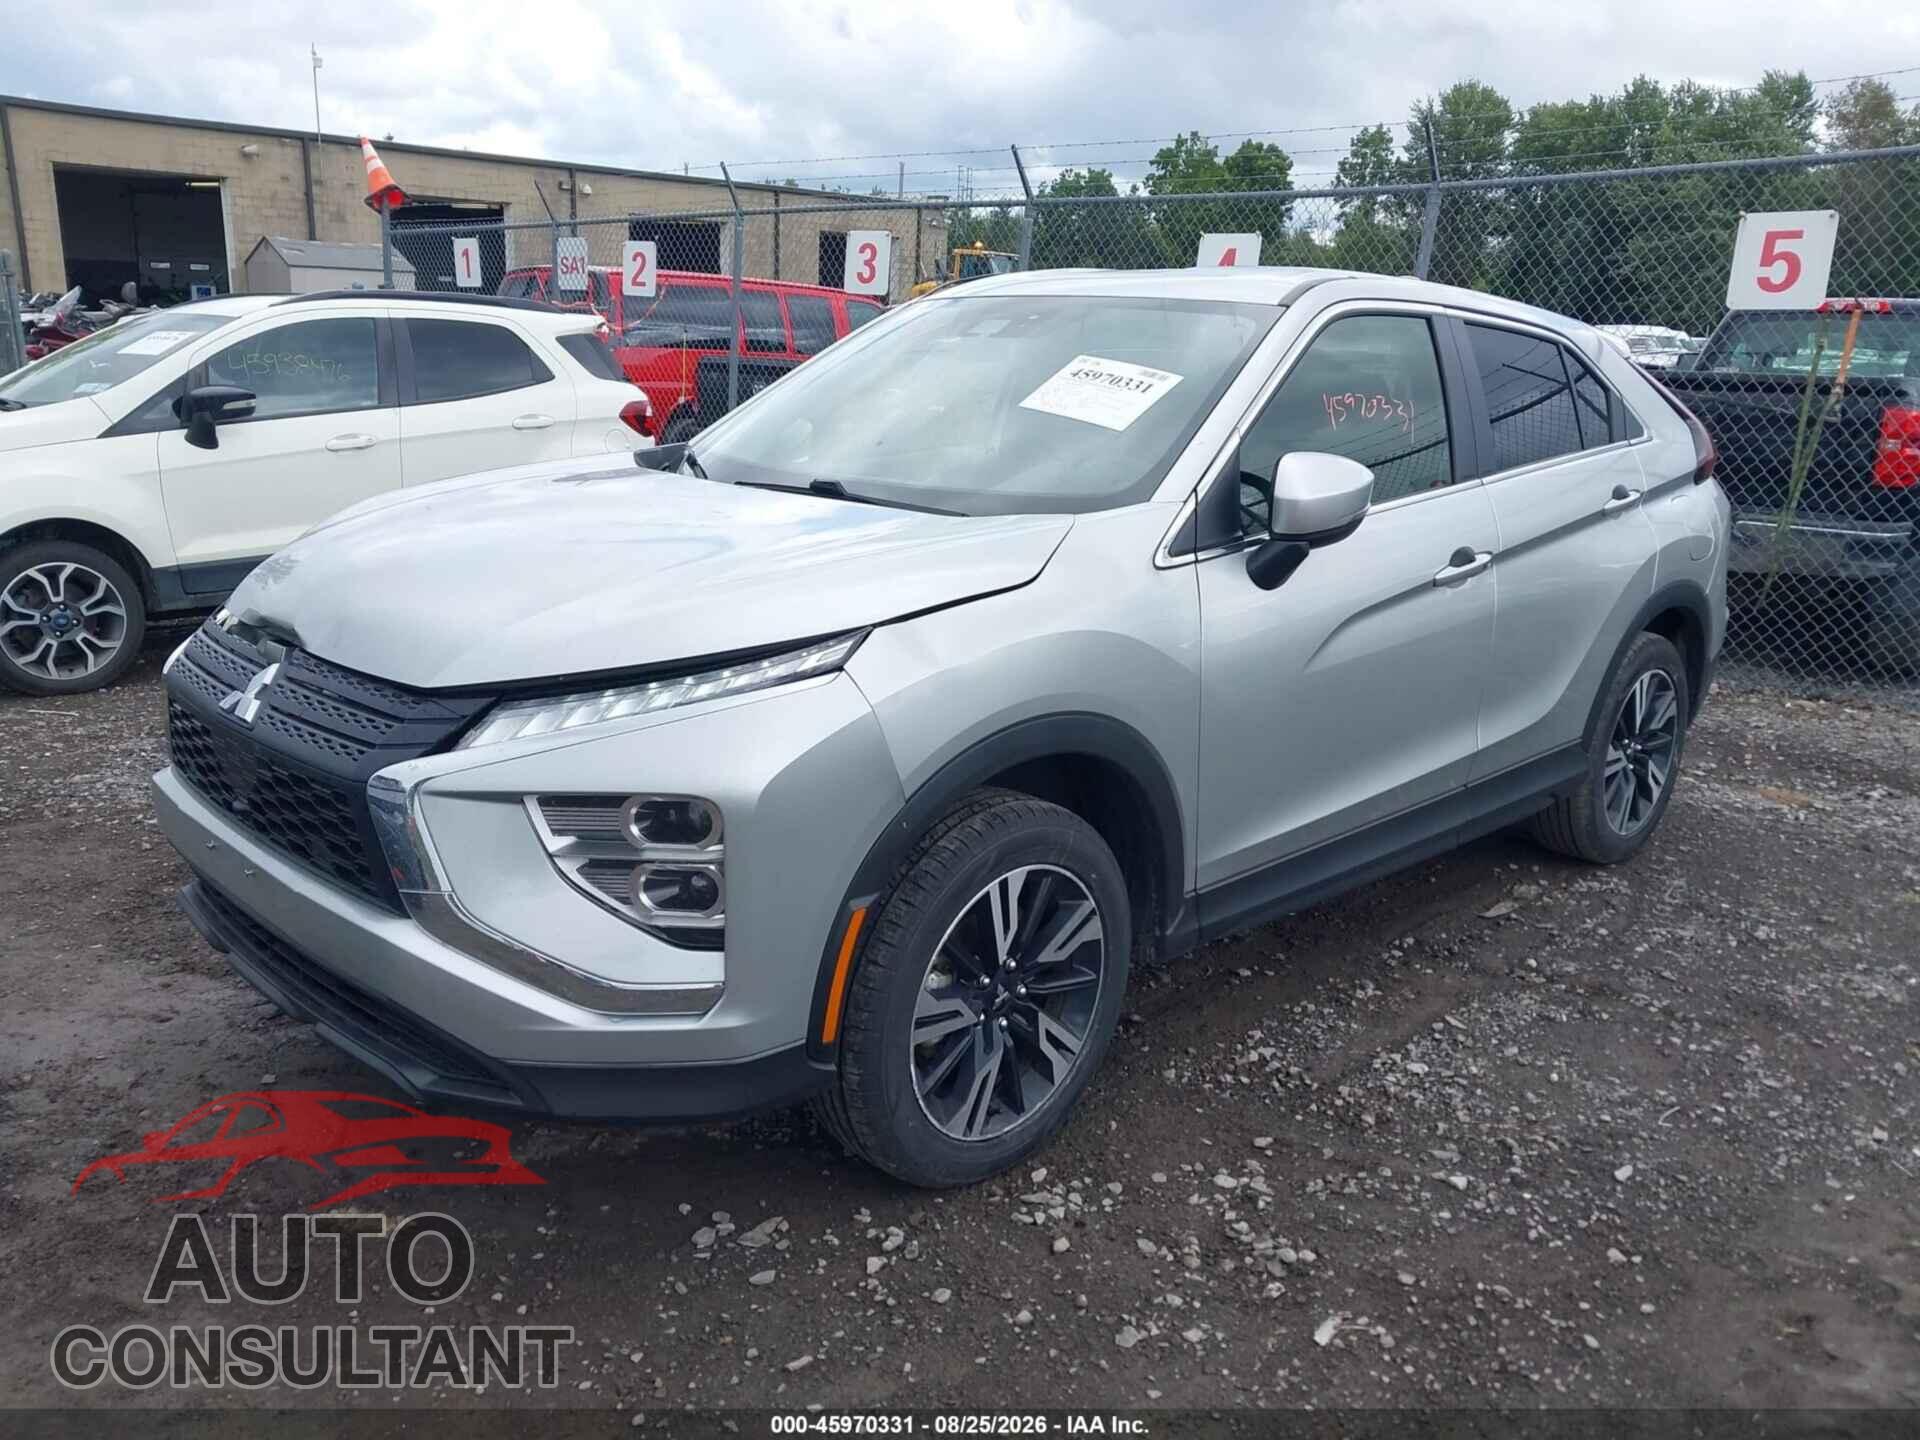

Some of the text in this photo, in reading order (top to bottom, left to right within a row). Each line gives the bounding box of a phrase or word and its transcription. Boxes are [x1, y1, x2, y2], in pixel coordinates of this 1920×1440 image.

[461, 247, 472, 279] 1
[560, 256, 586, 275] SA1
[631, 251, 647, 287] 2
[857, 243, 877, 284] 3
[1757, 230, 1804, 293] 5
[1071, 368, 1154, 394] 45970331
[1323, 393, 1415, 444] 45970331
